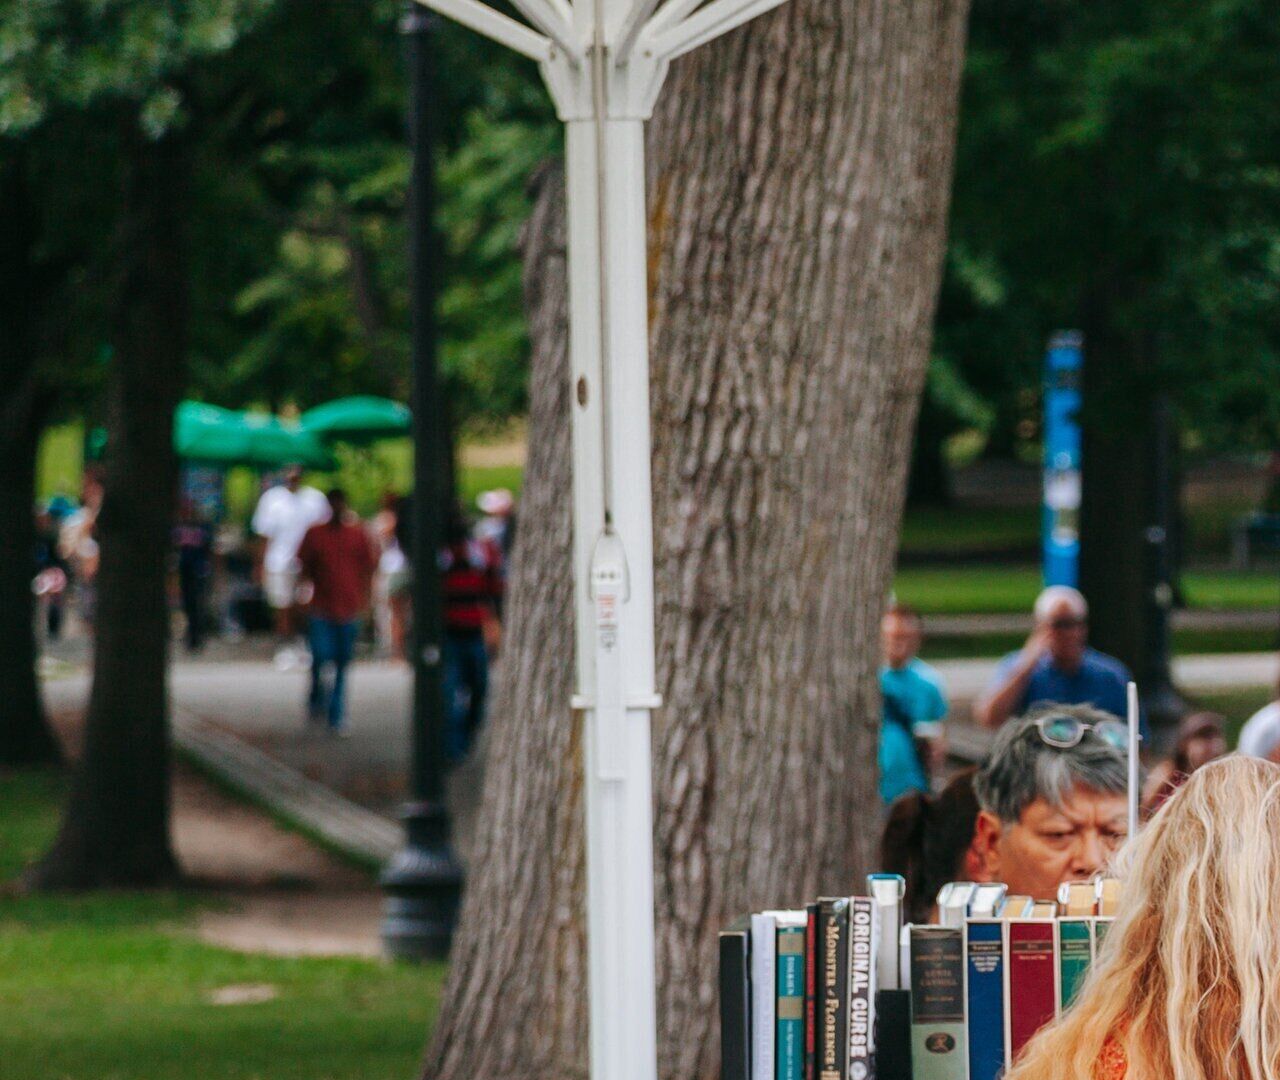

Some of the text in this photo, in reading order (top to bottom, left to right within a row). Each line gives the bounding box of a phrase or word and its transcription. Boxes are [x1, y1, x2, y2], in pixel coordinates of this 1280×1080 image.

[824, 999, 840, 1064] FLORENCE
[851, 912, 871, 1058] ORIGINAL CURSE
